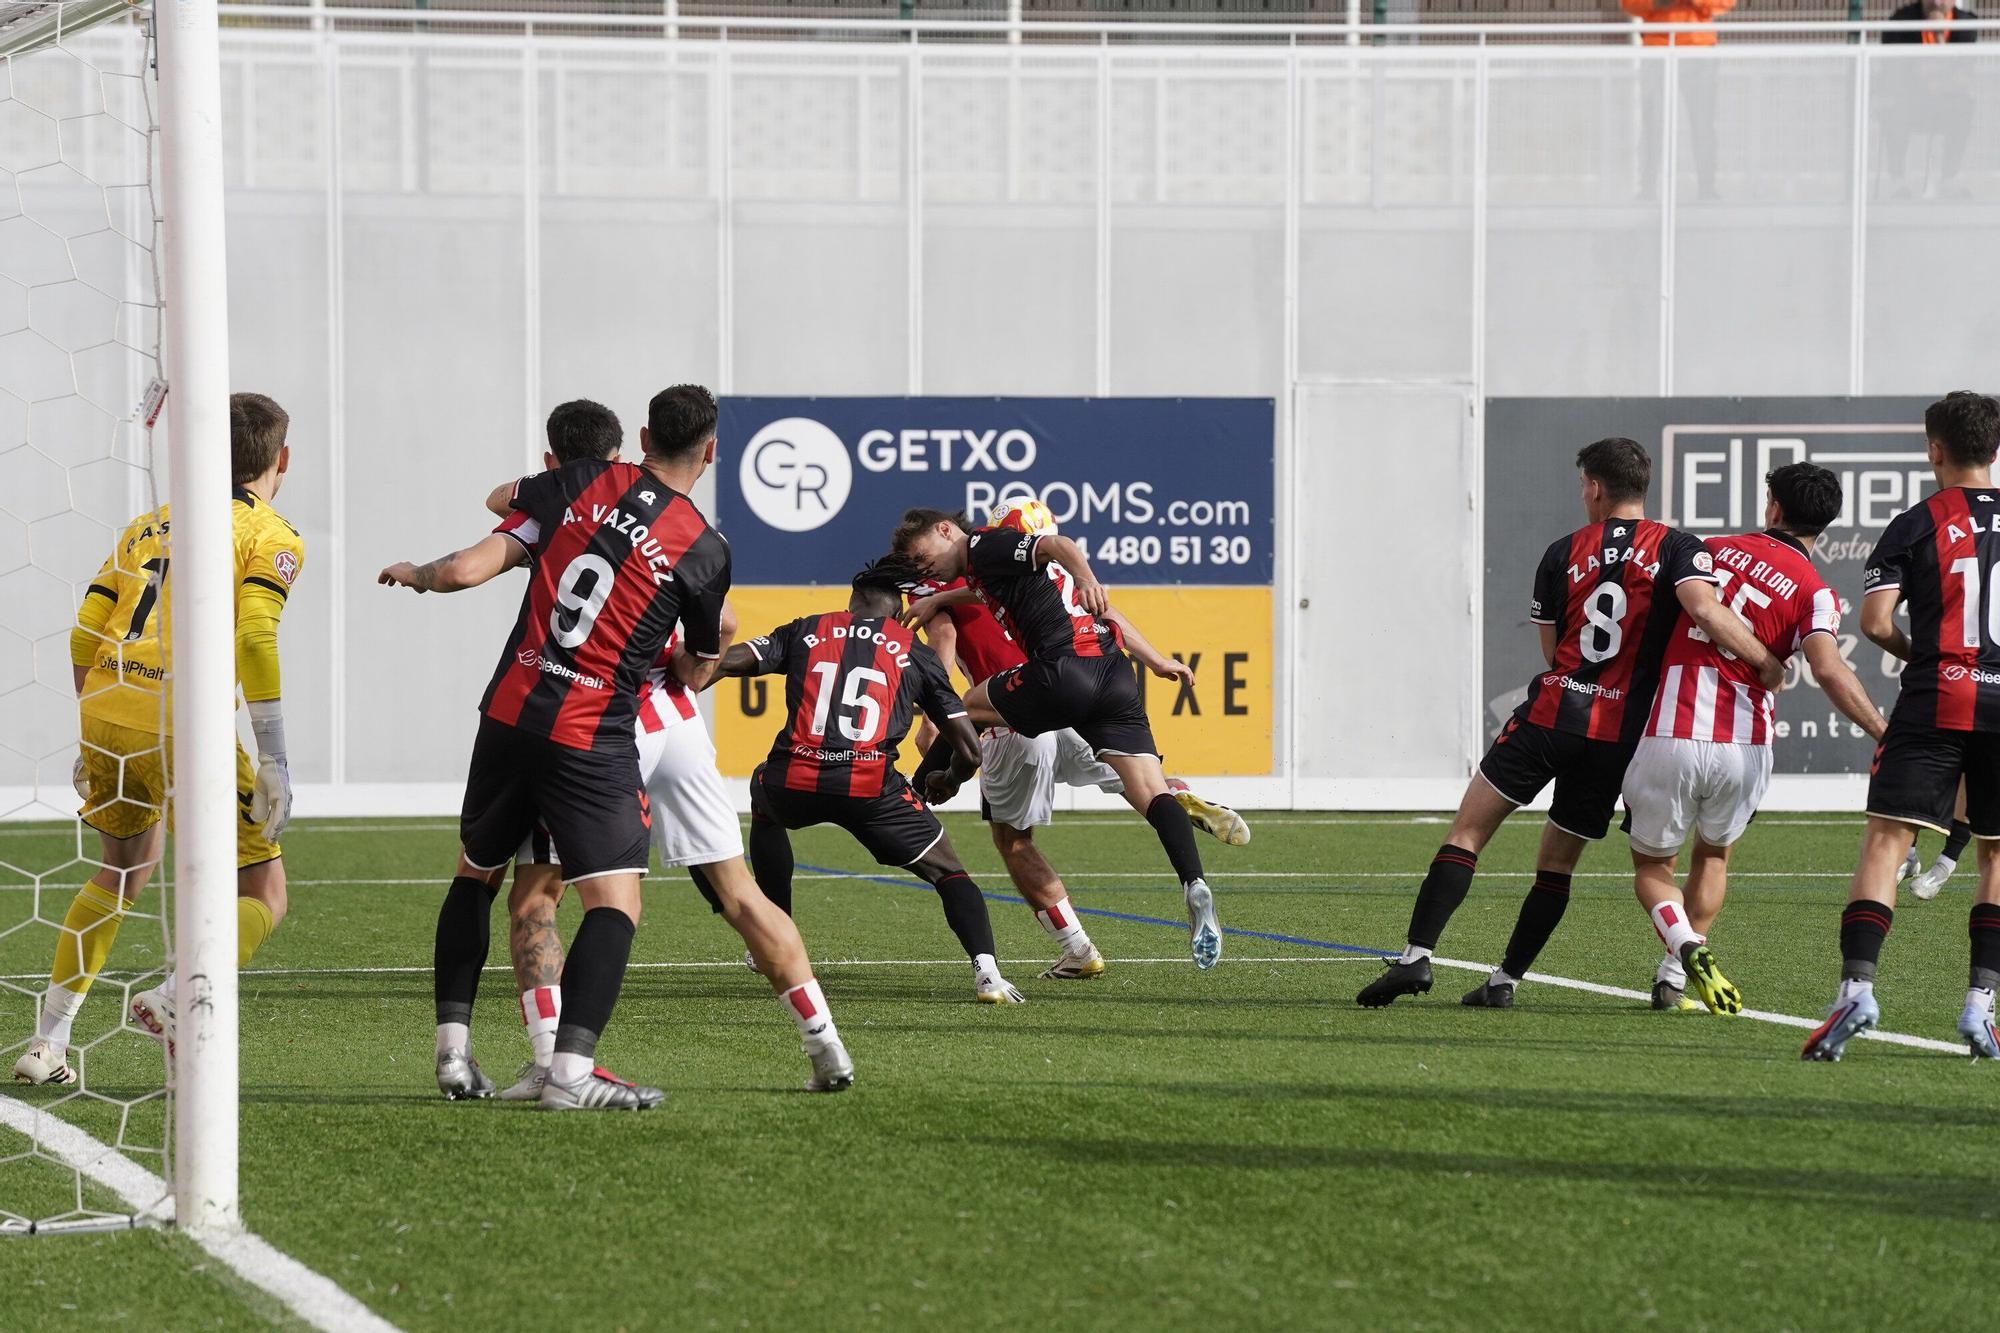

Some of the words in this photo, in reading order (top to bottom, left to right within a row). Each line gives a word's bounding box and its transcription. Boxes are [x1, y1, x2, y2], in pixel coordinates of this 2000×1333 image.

[858, 429, 1037, 472] GETXO
[1683, 438, 1743, 528] El
[562, 504, 583, 527] A.
[592, 503, 675, 587] VAZQUEZ
[1097, 535, 1162, 565] 480
[1169, 535, 1201, 565] 51
[1209, 535, 1251, 565] 30
[1567, 546, 1661, 584] ZABALA
[1714, 546, 1753, 572] IKER
[1749, 560, 1799, 601] ALDAI
[550, 553, 615, 650] 9
[1579, 581, 1628, 663] 8
[802, 633, 827, 650] B.
[832, 625, 911, 669] DIOCOU
[537, 656, 606, 691] SteelPhalt
[1559, 675, 1623, 700] SteelPhalt
[811, 660, 888, 742] 15
[815, 749, 882, 762] SteelPhalt
